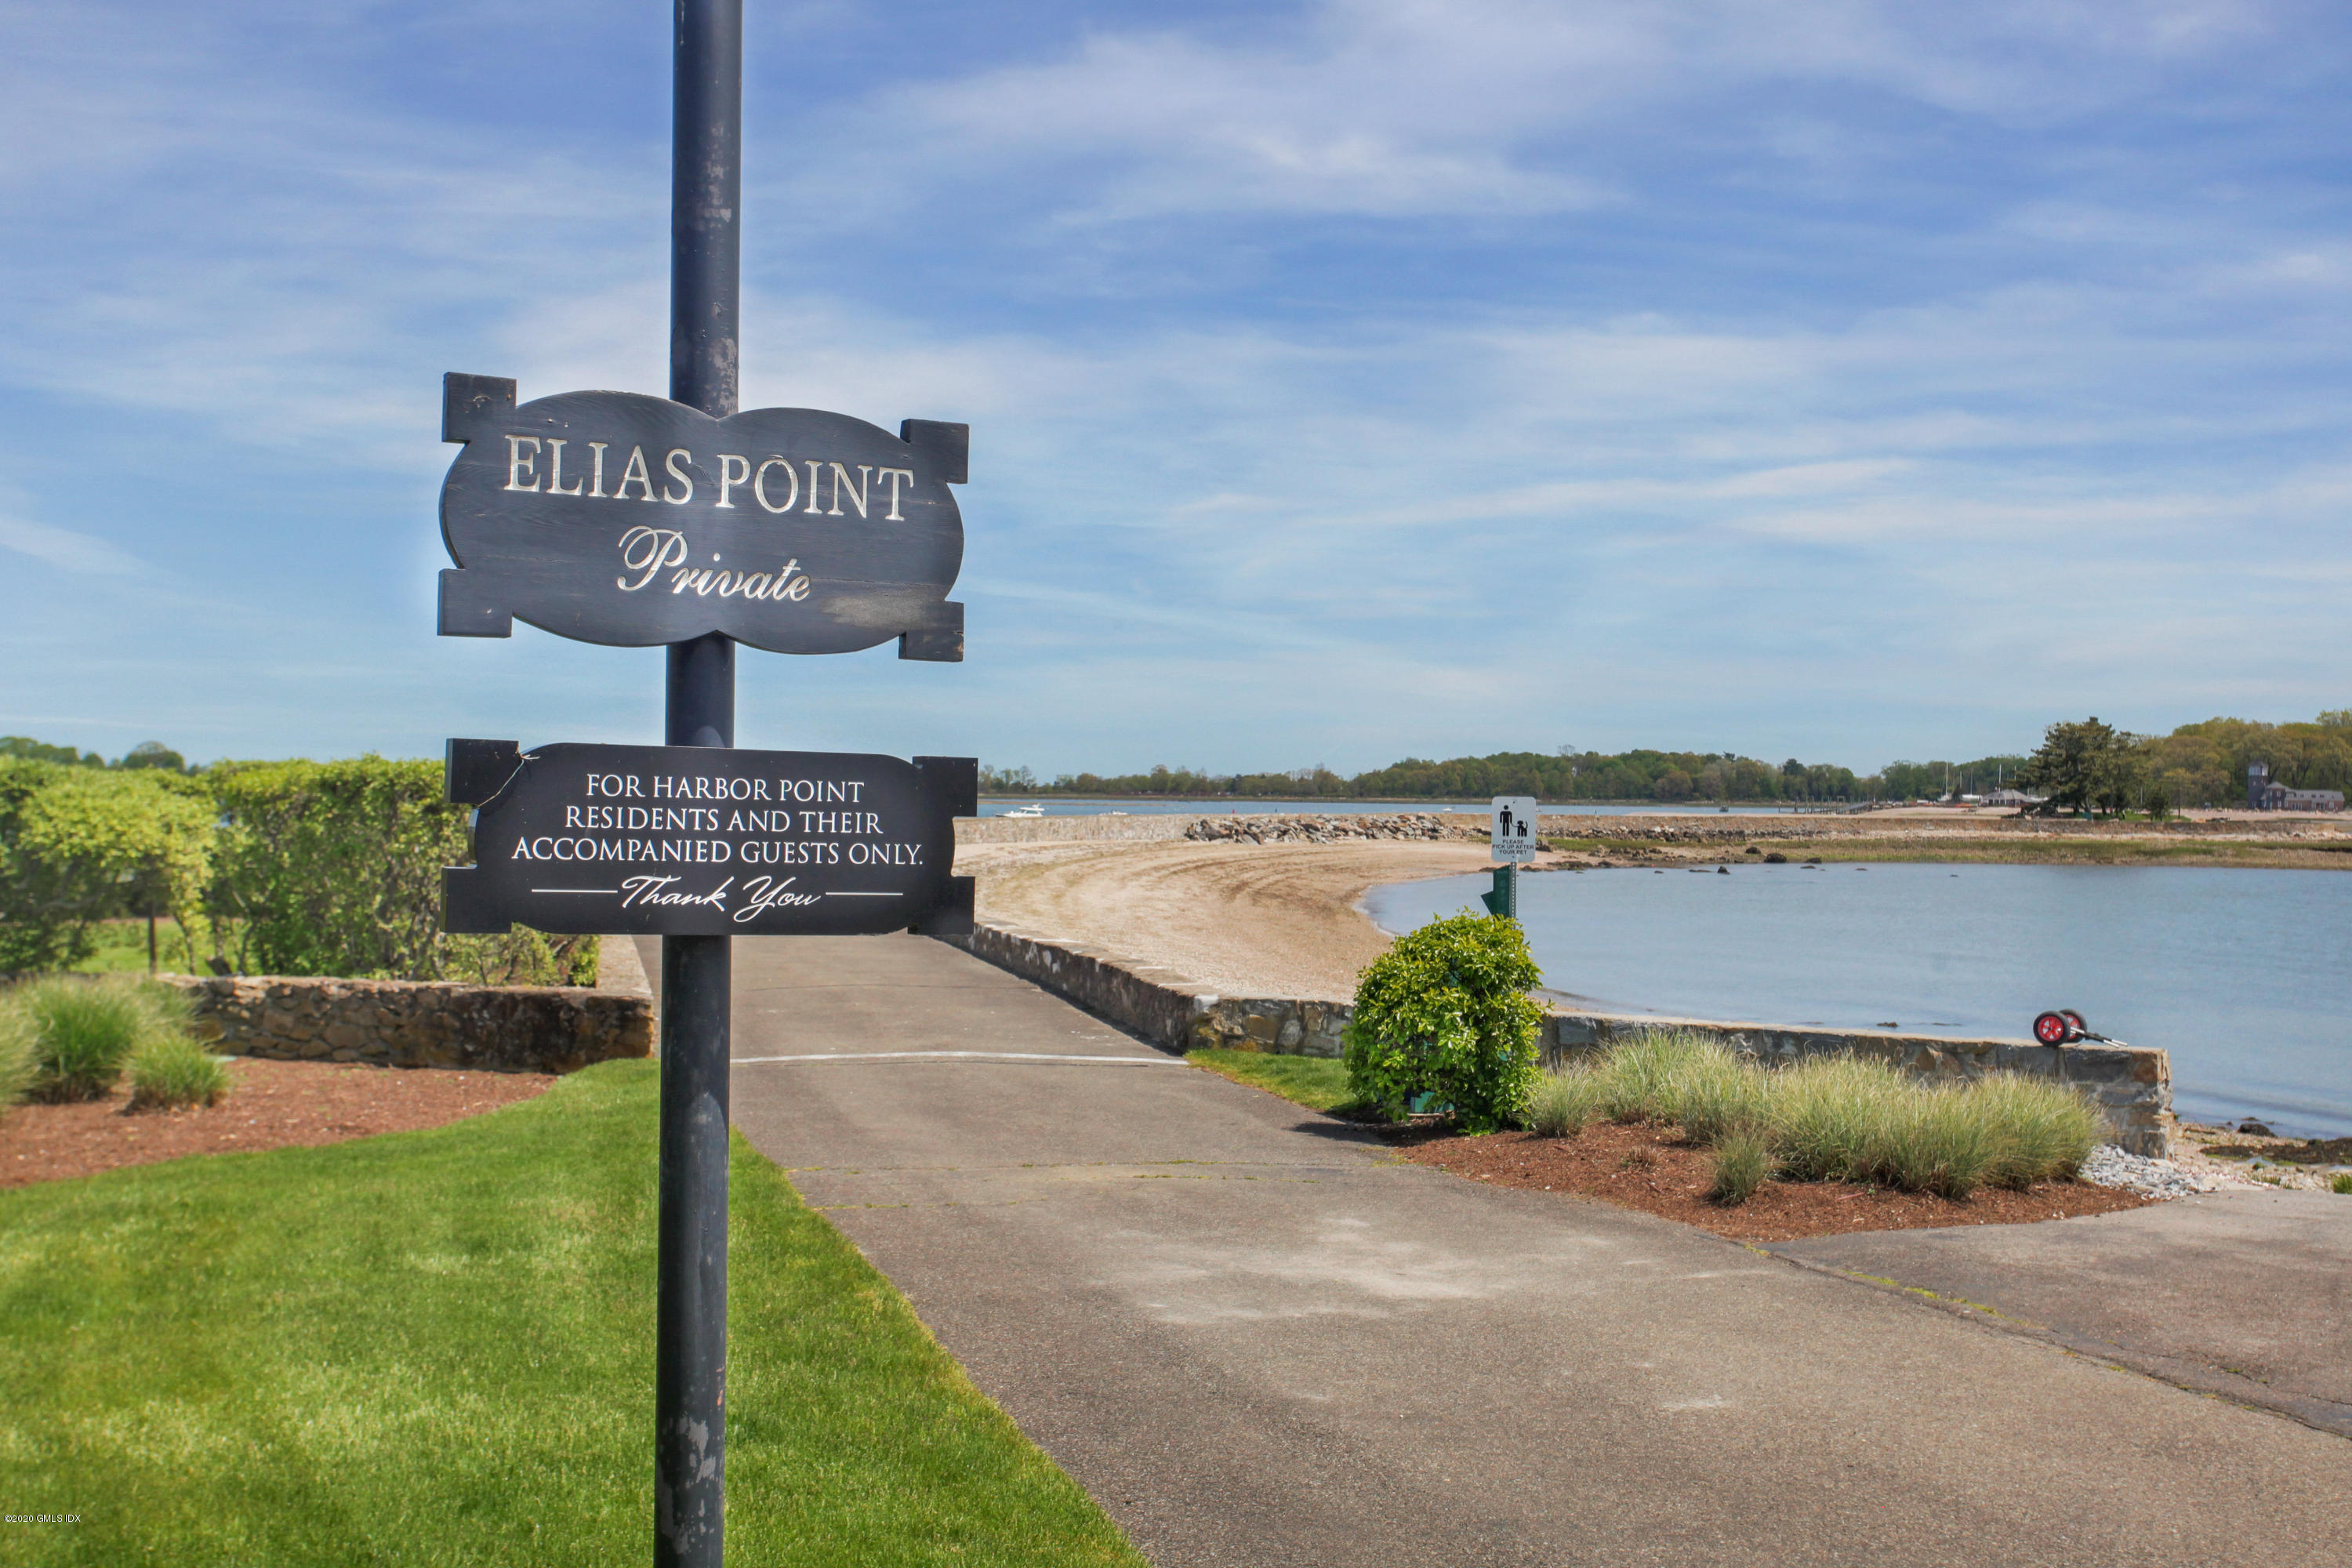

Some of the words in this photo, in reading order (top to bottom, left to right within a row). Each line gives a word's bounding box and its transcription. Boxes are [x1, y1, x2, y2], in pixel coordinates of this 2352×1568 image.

[504, 434, 694, 505] ELIAS
[715, 453, 913, 521] POINT
[617, 525, 811, 601] Private
[586, 774, 645, 797] FOR
[654, 776, 772, 801] HARBOR
[780, 780, 865, 803] POINT
[565, 806, 719, 831] RESIDENTS
[726, 810, 790, 832] AND
[797, 811, 884, 833] THEIR
[511, 837, 731, 863] ACCOMPANIED
[740, 842, 842, 863] GUESTS
[848, 845, 924, 865] ONLY.
[620, 875, 735, 912] Thank
[733, 877, 821, 922] You
